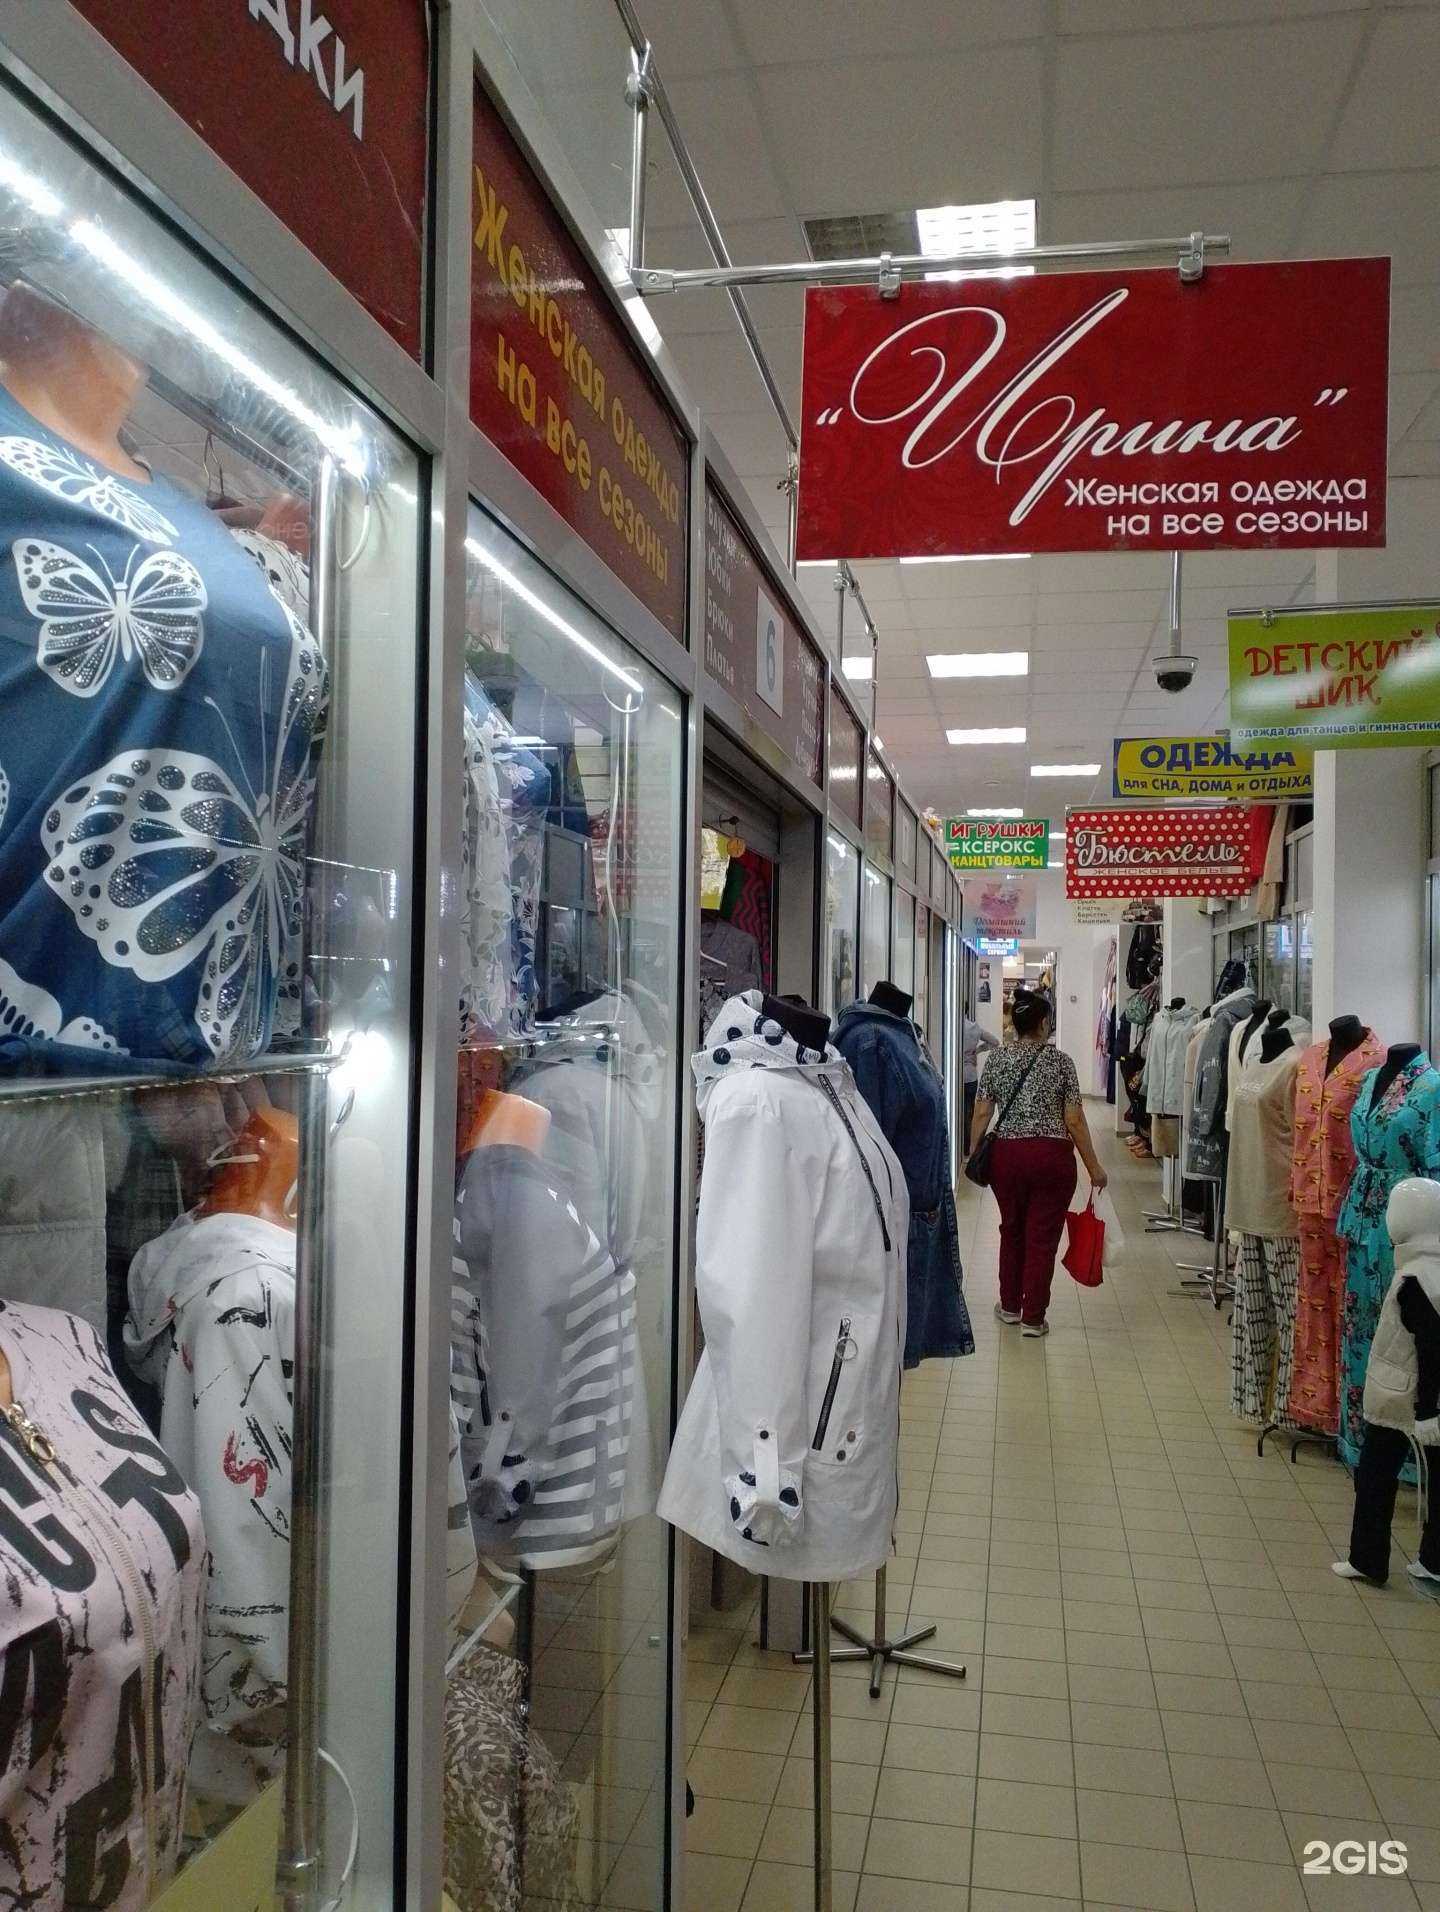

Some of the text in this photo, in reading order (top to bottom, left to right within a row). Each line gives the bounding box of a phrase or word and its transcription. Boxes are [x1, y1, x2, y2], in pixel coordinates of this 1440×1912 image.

[472, 165, 680, 526] Женская одежда
[497, 333, 669, 586] на все сезоны
[1064, 476, 1368, 507] Женская одежда
[1107, 510, 1369, 536] на все сезоны
[707, 587, 734, 643] Брюки
[766, 618, 776, 692] 6
[1295, 673, 1381, 709] ШИК
[1238, 727, 1285, 739] одежда
[1287, 726, 1310, 737] для
[1313, 724, 1357, 736] танцев
[1359, 724, 1367, 733] и
[1123, 774, 1312, 794] для СНА, ДОМА и ОТДЫХА
[951, 822, 1045, 838] ИГРУШКИ
[962, 840, 1036, 853] КСЕРОКС
[951, 855, 1044, 868] КАНЦТОВАРЫ
[1094, 866, 1230, 875] ЖЕНСКОЕ БЕЛЬЕ
